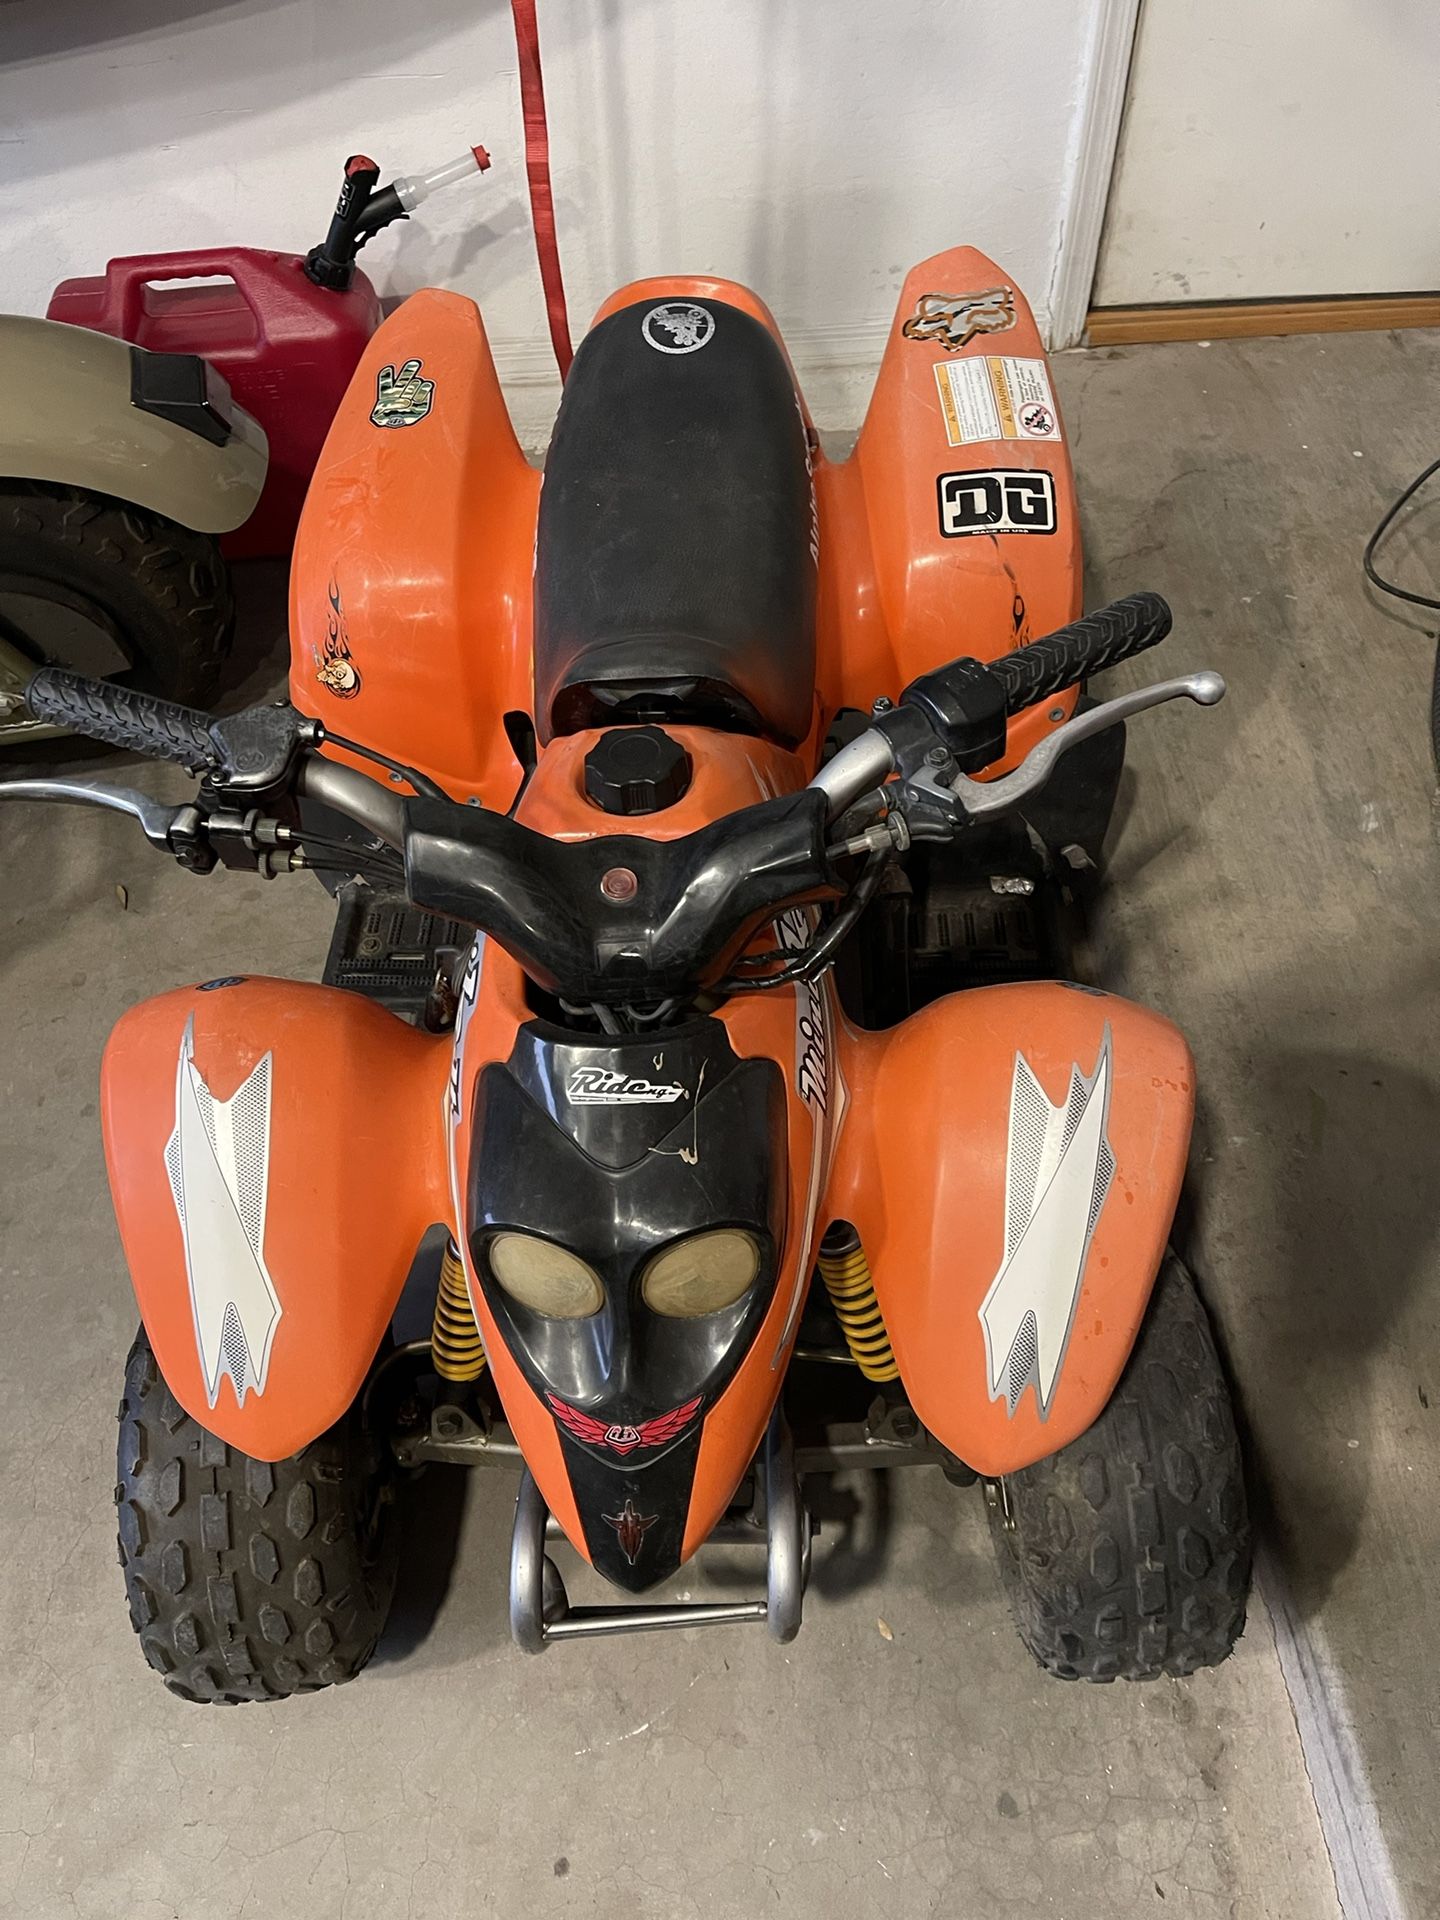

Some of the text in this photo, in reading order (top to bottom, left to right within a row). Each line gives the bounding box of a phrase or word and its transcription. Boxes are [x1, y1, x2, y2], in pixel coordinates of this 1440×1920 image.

[942, 383, 954, 413] WARNING
[994, 370, 1009, 410] WARNING
[945, 476, 1048, 528] DG
